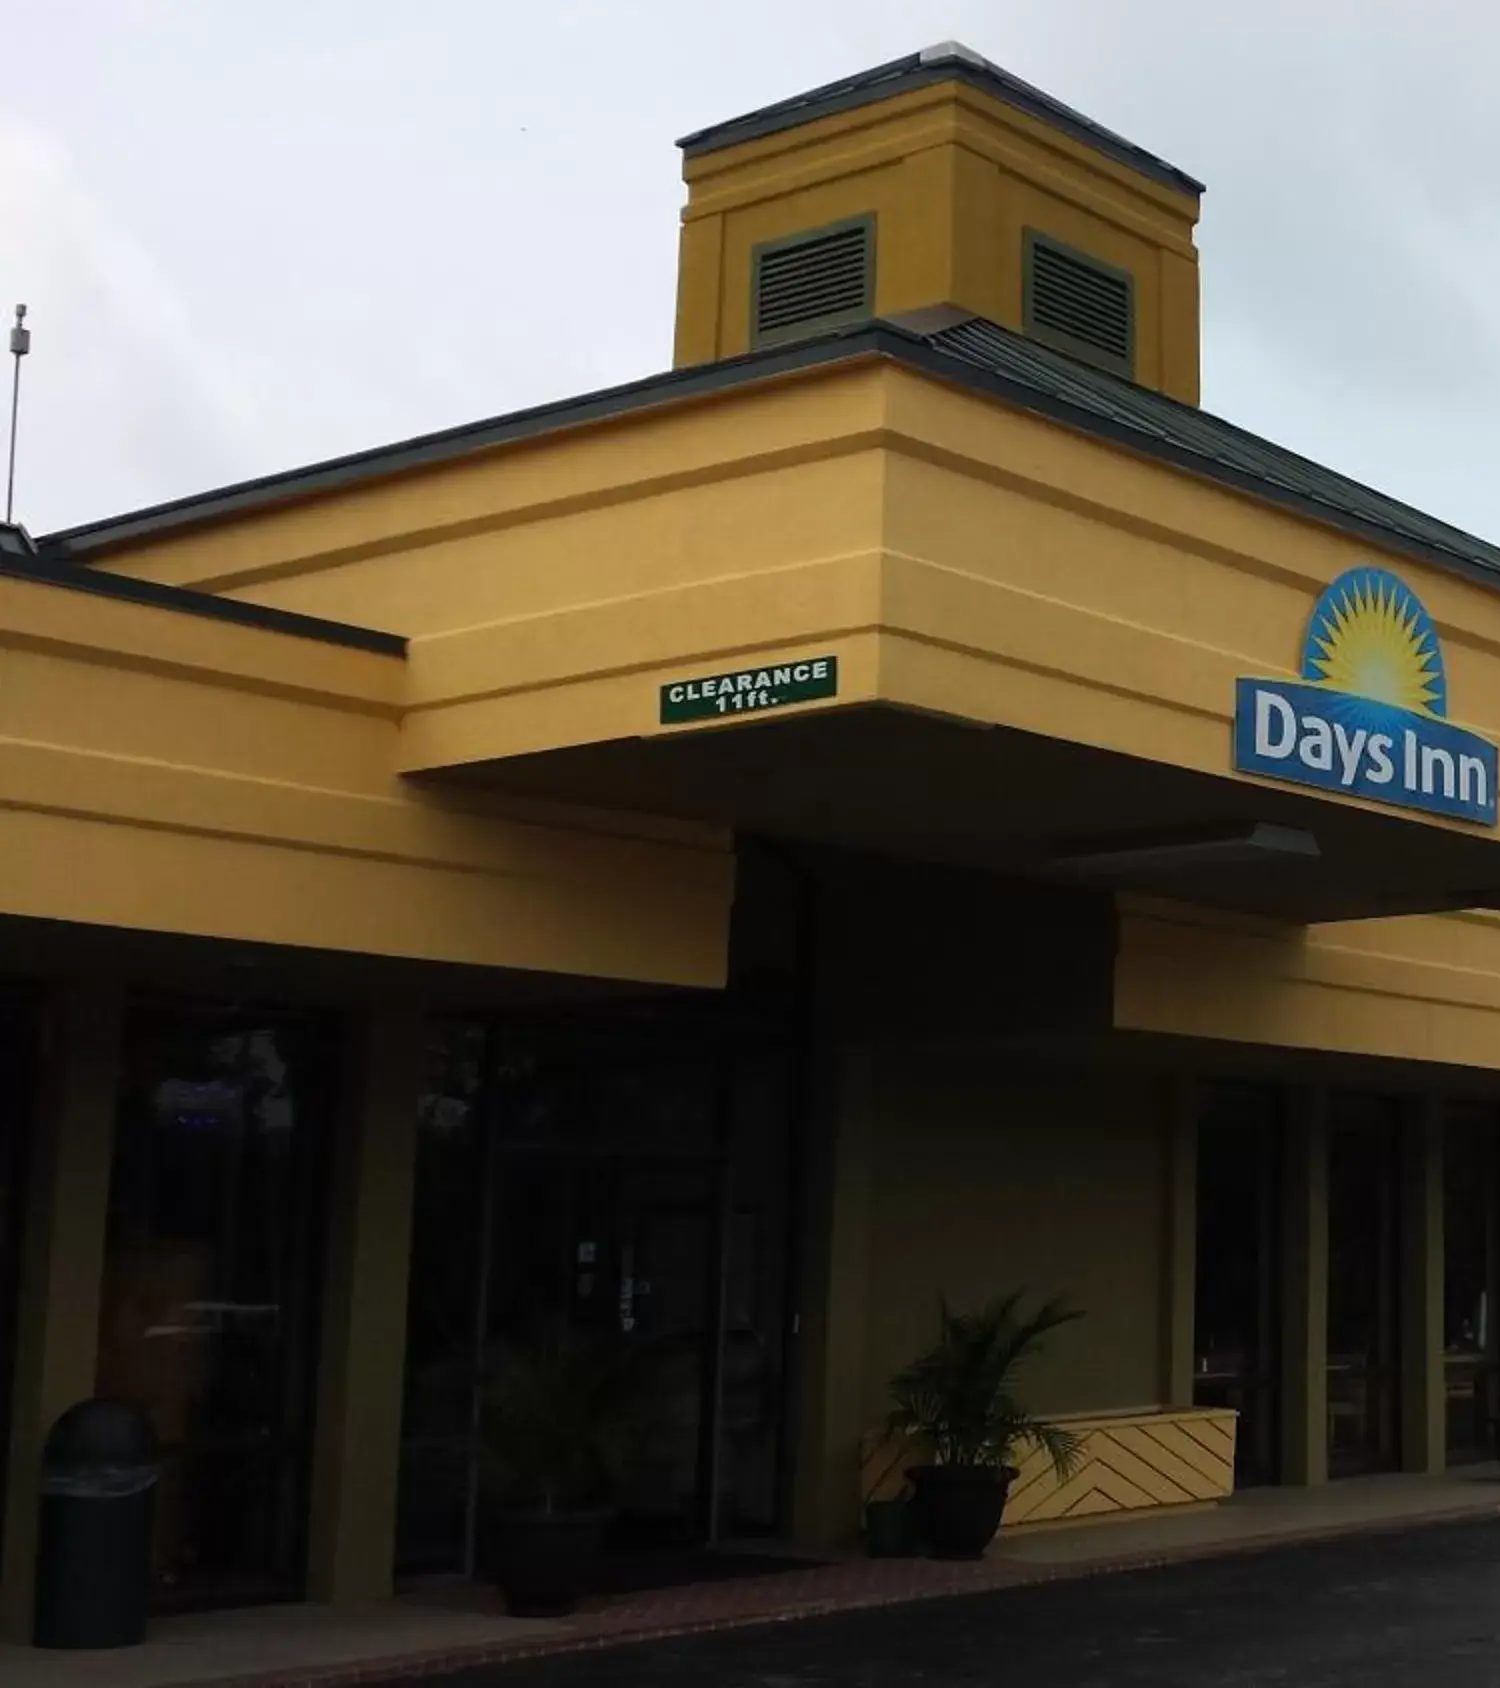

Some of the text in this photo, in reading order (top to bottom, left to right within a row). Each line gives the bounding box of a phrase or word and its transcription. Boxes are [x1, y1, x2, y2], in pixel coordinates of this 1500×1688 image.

[669, 661, 828, 703] CLEARANCE
[1255, 690, 1487, 806] Days Inn
